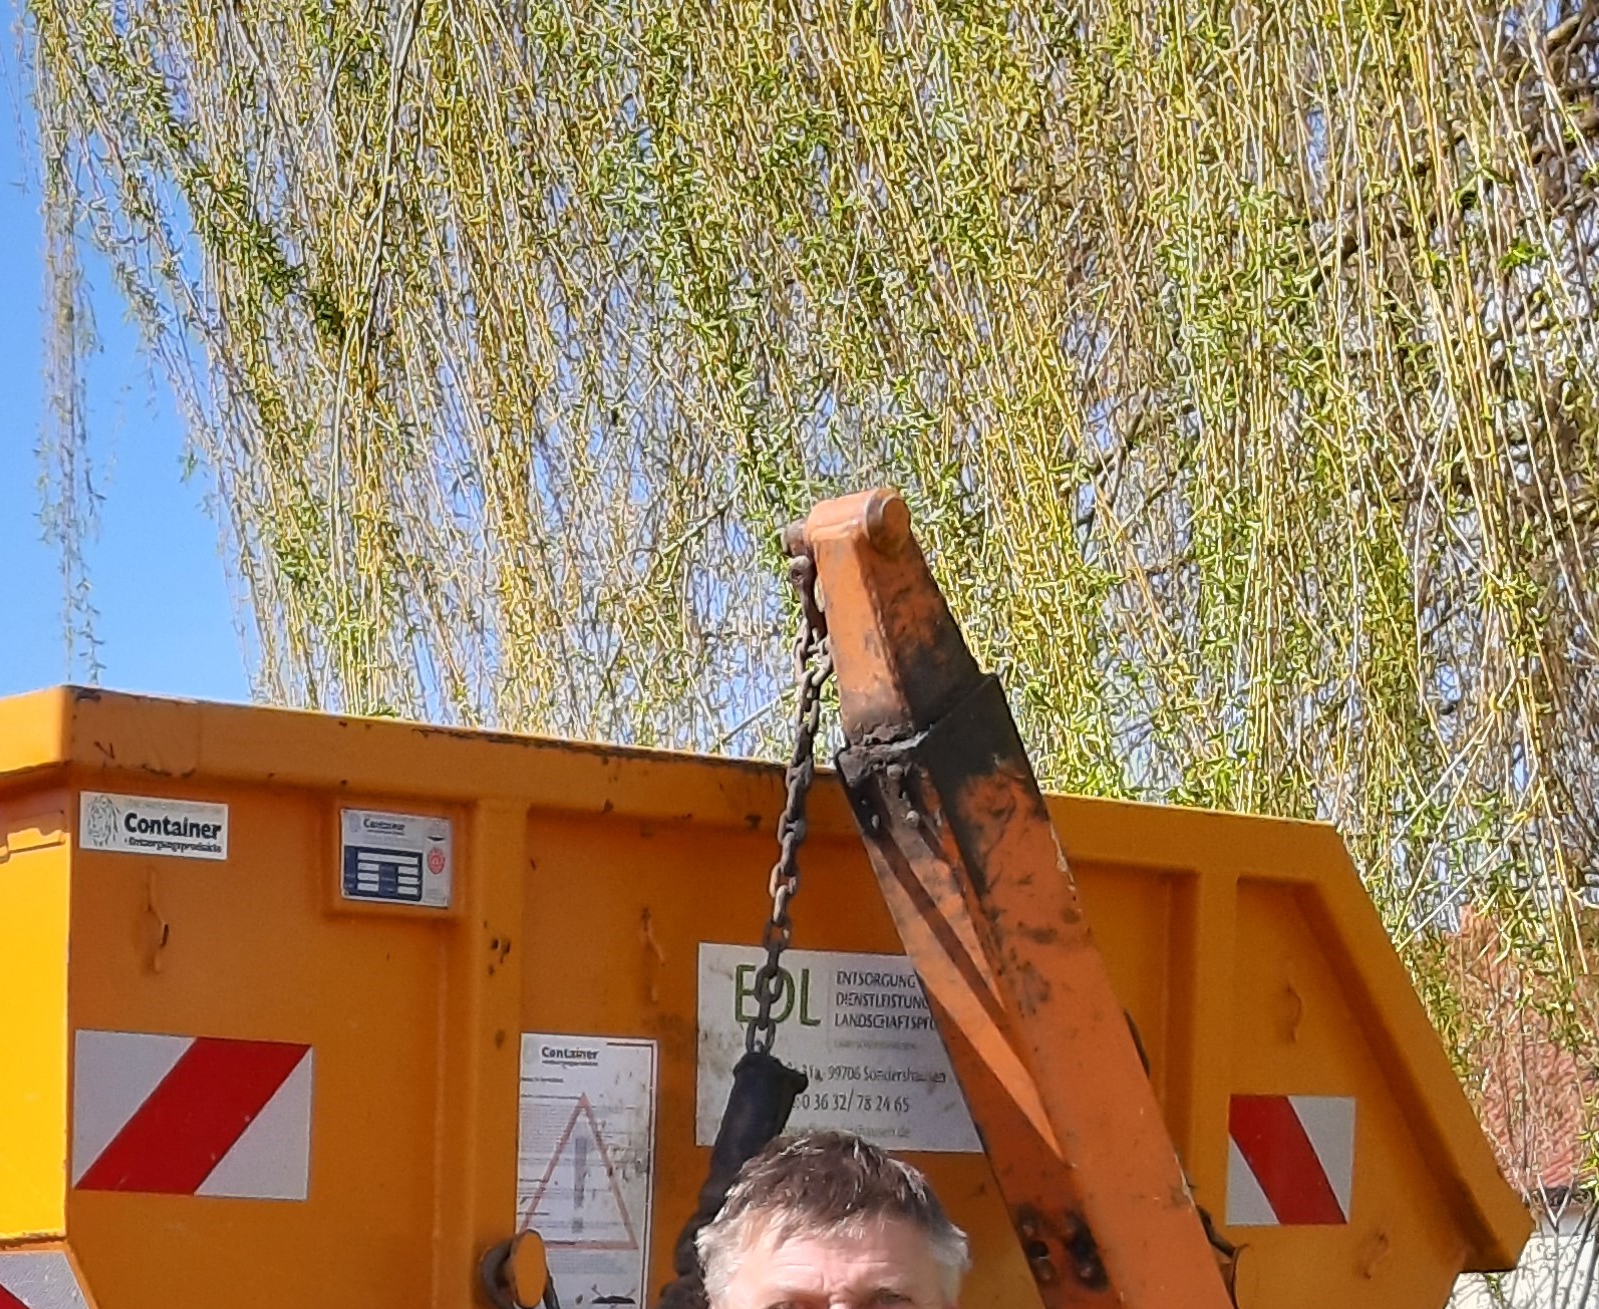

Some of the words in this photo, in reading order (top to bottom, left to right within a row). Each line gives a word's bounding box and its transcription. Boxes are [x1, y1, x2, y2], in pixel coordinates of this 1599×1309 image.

[124, 812, 222, 840] Container
[836, 970, 916, 988] ENTSORGUNG
[834, 1013, 935, 1030] LANDSCHAFTSPFL
[541, 1046, 600, 1060] Container
[828, 1064, 862, 1081] 99706
[813, 1094, 829, 1111] 36
[857, 1094, 872, 1111] 78
[875, 1095, 891, 1112] 24
[894, 1095, 909, 1113] 65
